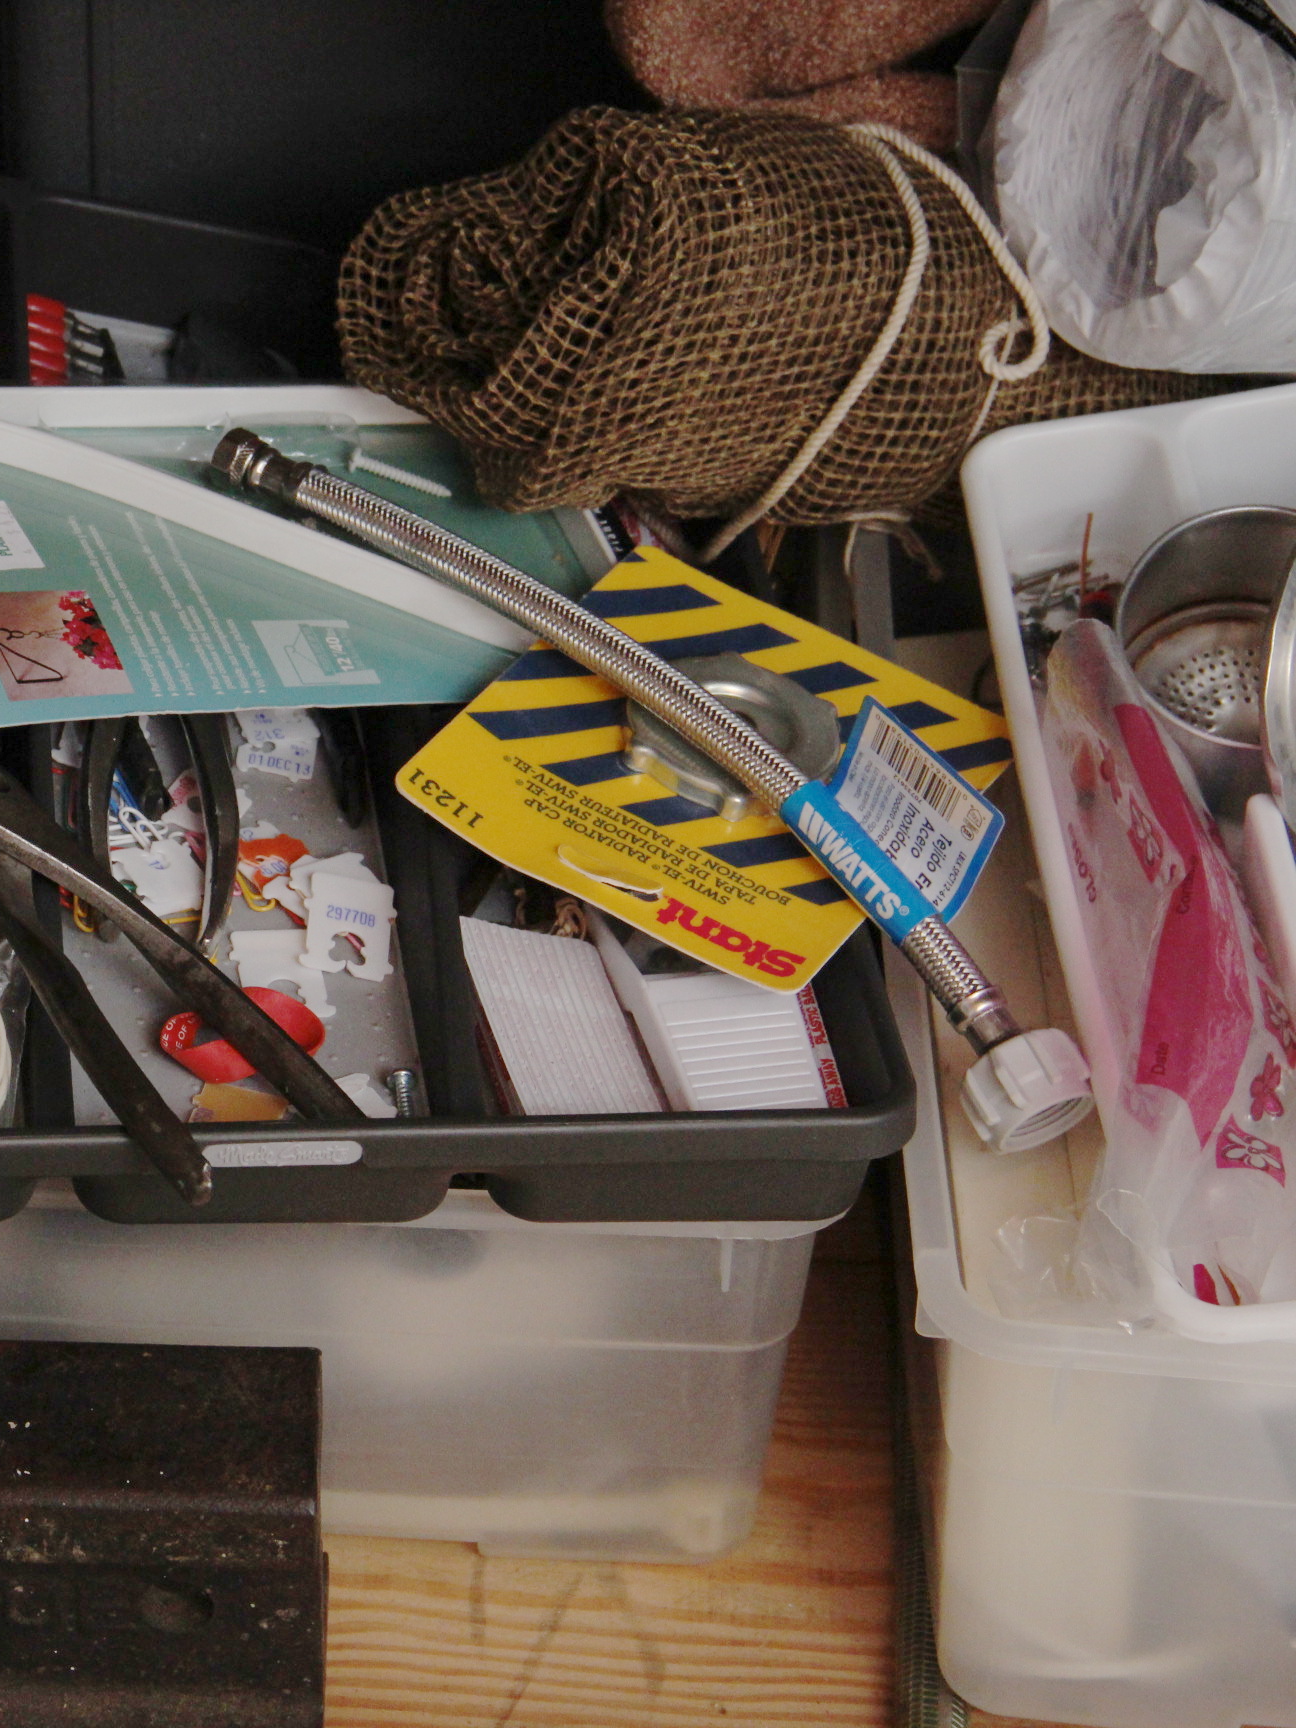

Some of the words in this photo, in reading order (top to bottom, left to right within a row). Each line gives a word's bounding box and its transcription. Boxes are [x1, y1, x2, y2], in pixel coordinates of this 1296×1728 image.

[408, 768, 483, 827] 11231
[513, 756, 578, 799] SWIV-EL
[523, 798, 560, 820] CAP
[526, 780, 591, 820] SWIV-EL
[562, 817, 650, 863] RADIATOR
[579, 796, 674, 847] RADIATEUR
[592, 817, 683, 866] RADIADOR
[910, 817, 935, 858] Acero
[675, 843, 701, 861] DE
[685, 863, 710, 880] DE
[807, 815, 902, 918] WATTS
[926, 833, 952, 872] Tejido
[662, 864, 729, 904] SWIV-EL
[703, 858, 790, 905] BOUCHON
[714, 876, 756, 905] TAPA
[655, 896, 806, 977] Stant
[1149, 1040, 1169, 1075] Date
